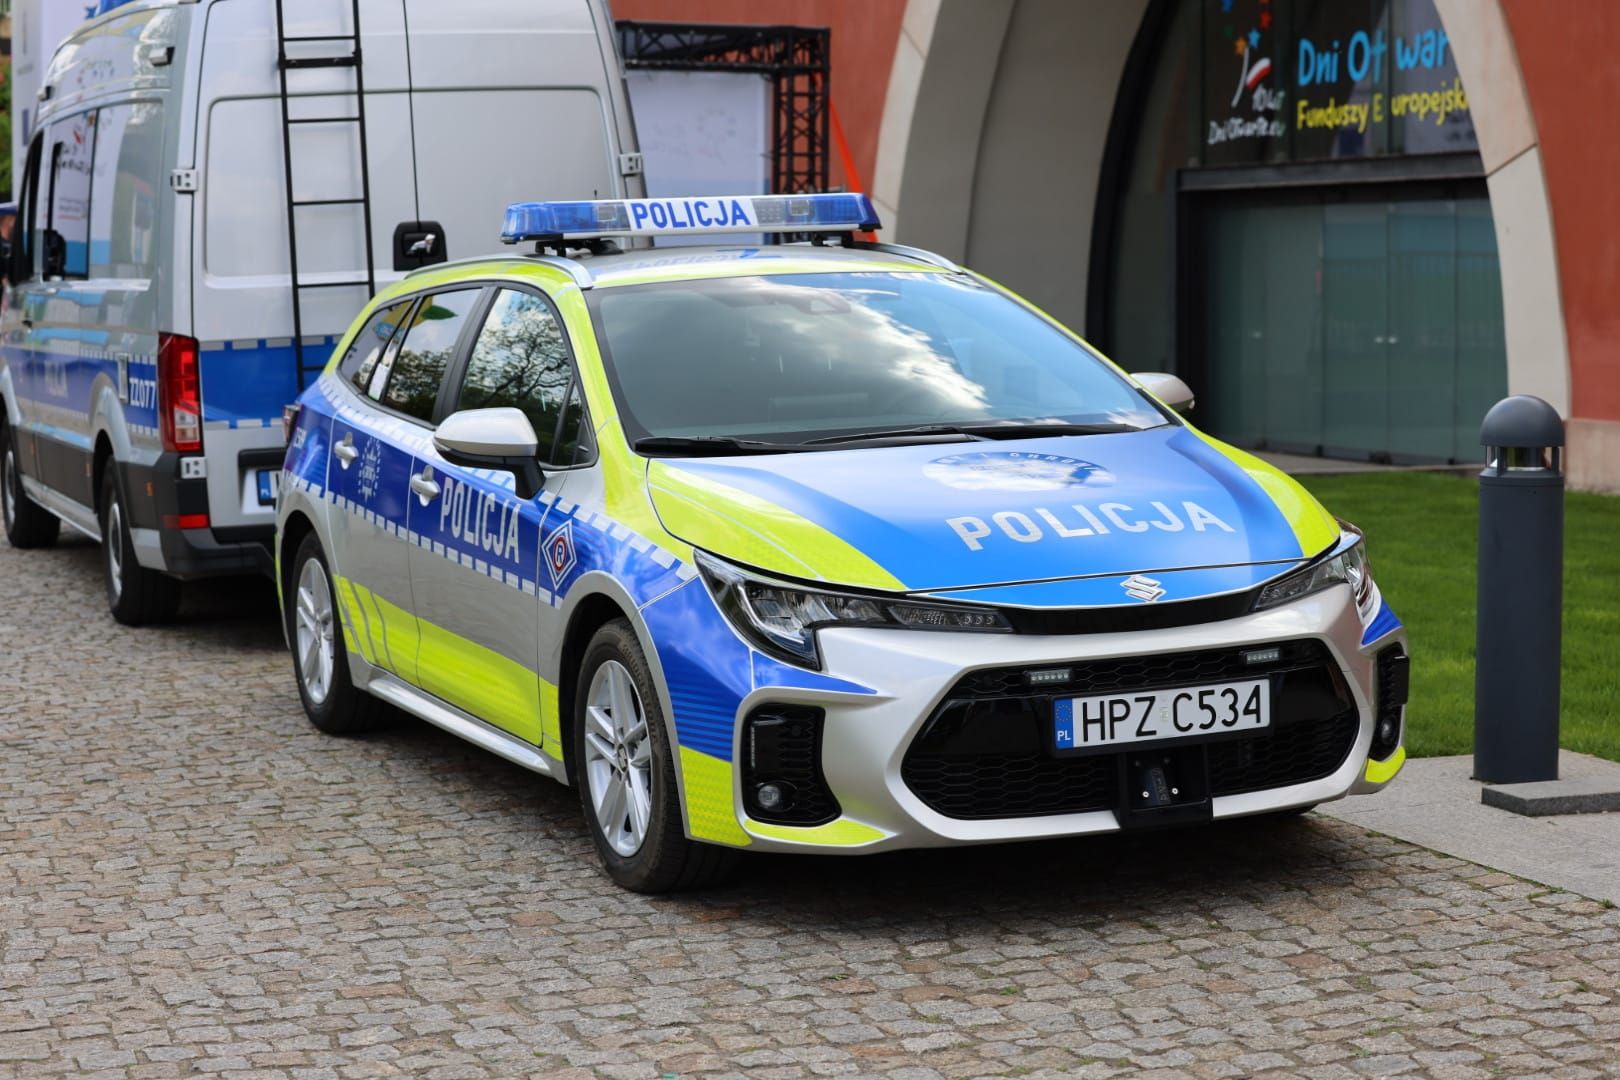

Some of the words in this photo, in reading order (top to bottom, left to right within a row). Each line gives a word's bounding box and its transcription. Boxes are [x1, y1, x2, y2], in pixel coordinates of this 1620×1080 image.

[1298, 38, 1339, 86] Dni
[1297, 98, 1368, 133] Funduszy
[631, 199, 752, 230] POLICJA
[440, 476, 521, 565] POLICJA
[945, 500, 1236, 552] POLICJA
[1057, 730, 1071, 742] PL
[1082, 694, 1158, 742] HPZ
[1172, 684, 1262, 732] C534
